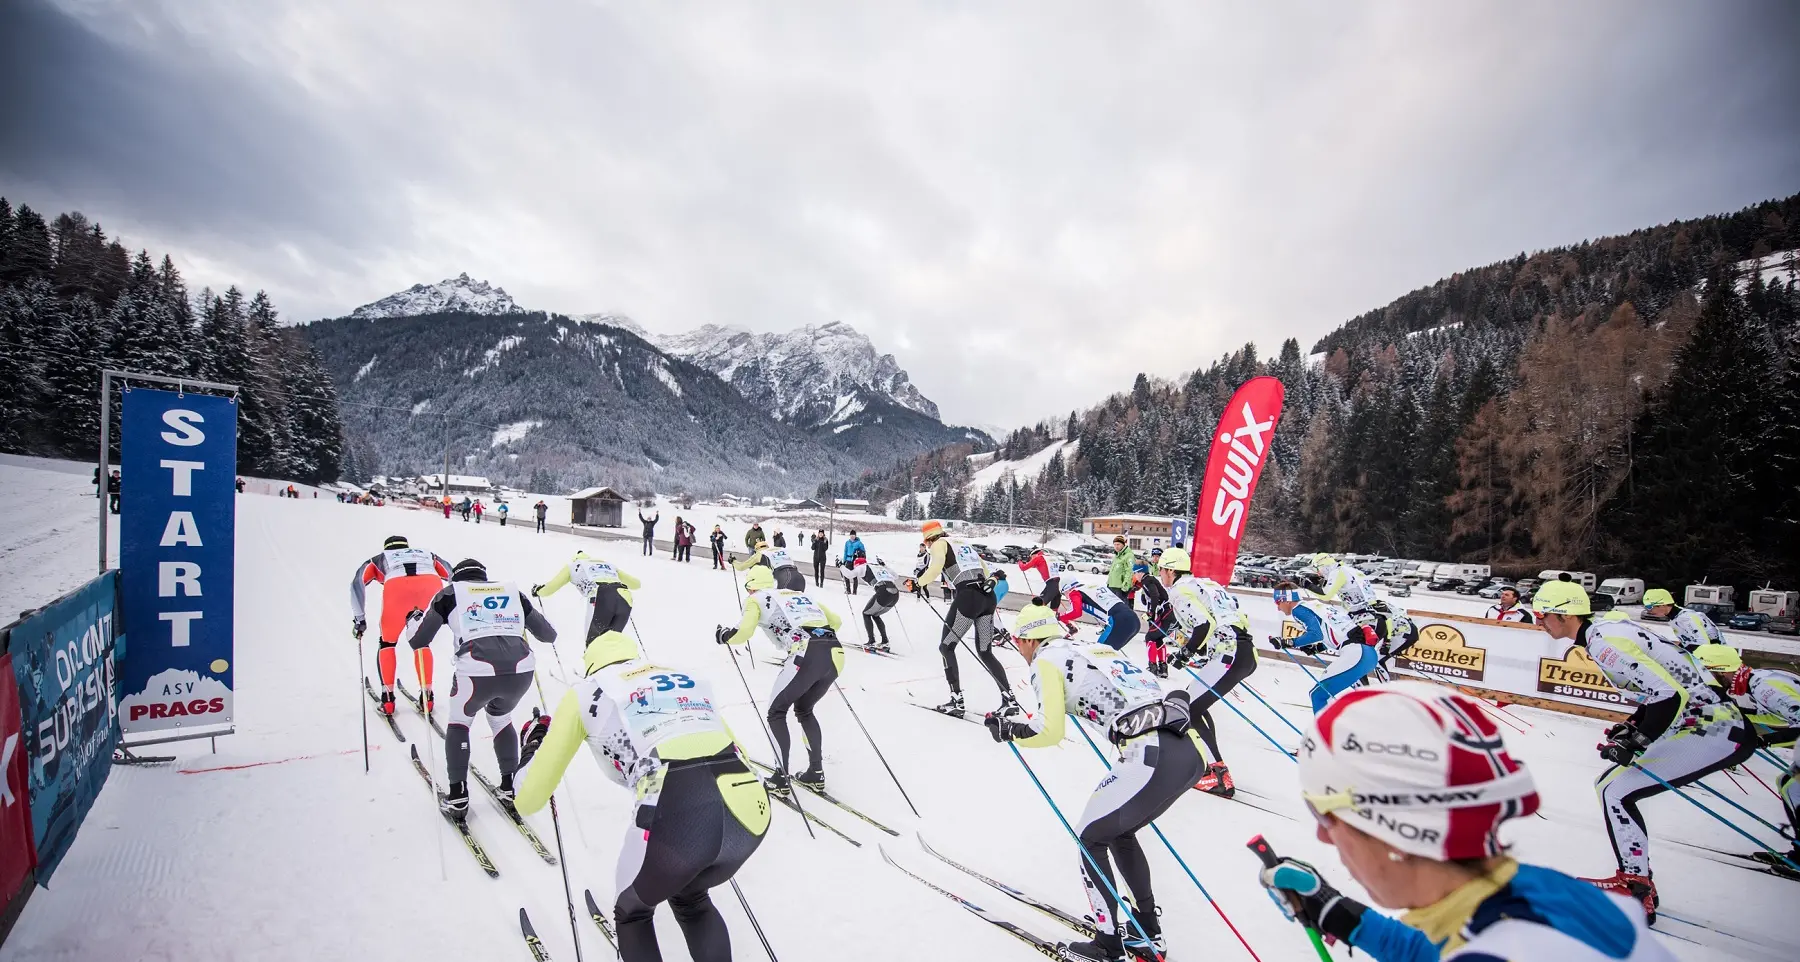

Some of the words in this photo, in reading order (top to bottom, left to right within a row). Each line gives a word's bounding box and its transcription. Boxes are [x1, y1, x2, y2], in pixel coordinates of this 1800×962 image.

[159, 408, 206, 647] START
[483, 595, 510, 610] 67
[791, 596, 813, 605] 23
[1112, 660, 1143, 675] 25
[1545, 664, 1613, 688] Trenk
[648, 673, 696, 691] 33
[1553, 684, 1629, 704] SÜDTIROL
[130, 697, 225, 722] PRAGS
[1366, 741, 1440, 762] odlo
[1095, 775, 1118, 791] TURA
[1414, 788, 1486, 805] WAY
[1377, 813, 1441, 844] NOR
